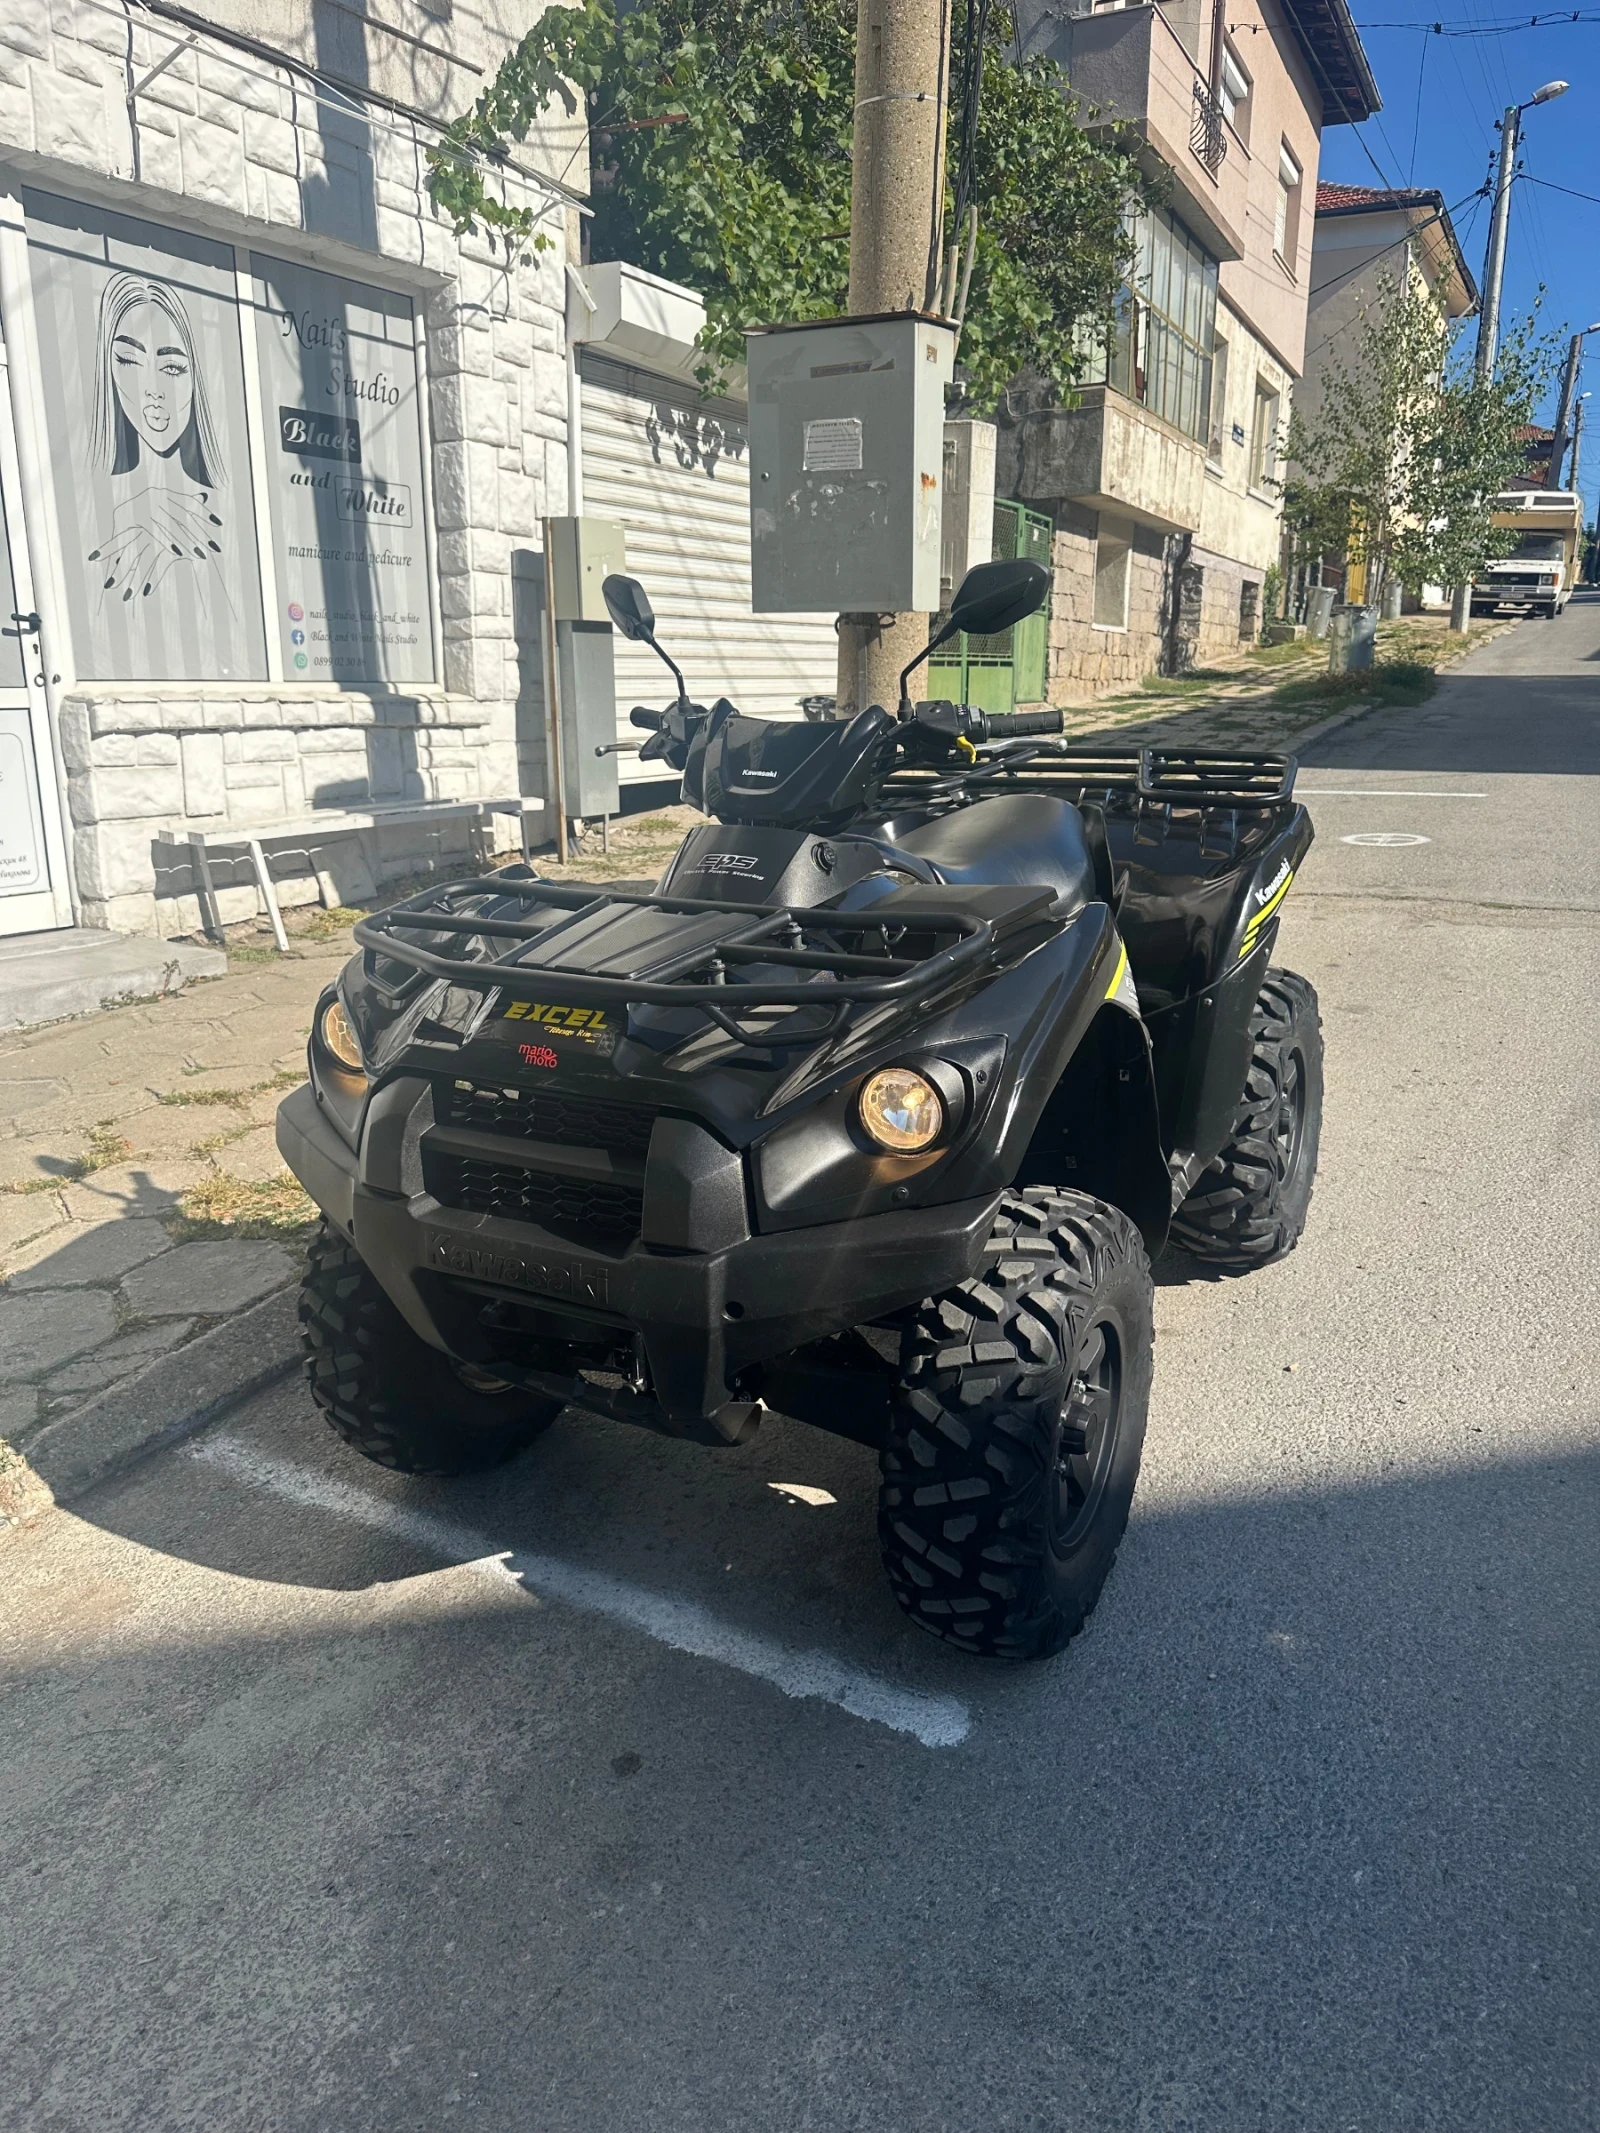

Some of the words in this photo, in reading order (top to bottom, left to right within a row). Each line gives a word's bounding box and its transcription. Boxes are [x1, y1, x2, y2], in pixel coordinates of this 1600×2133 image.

[282, 311, 346, 350] Nails
[326, 367, 400, 405] Studio
[283, 417, 358, 452] Black
[290, 471, 331, 489] and
[341, 488, 406, 517] White
[288, 544, 341, 561] manicure
[344, 547, 368, 562] and
[368, 549, 412, 568] pedicure
[335, 632, 349, 642] and
[395, 633, 418, 645] Studio
[313, 656, 333, 667] 0899
[334, 656, 344, 667] 02
[742, 769, 778, 778] Kawasaki
[697, 853, 759, 870] EPS
[1254, 857, 1290, 906] Kawasaki
[503, 1001, 608, 1029] EXCEL
[518, 1044, 553, 1057] mario
[525, 1053, 558, 1068] moto
[425, 1230, 609, 1304] Kawasaki
